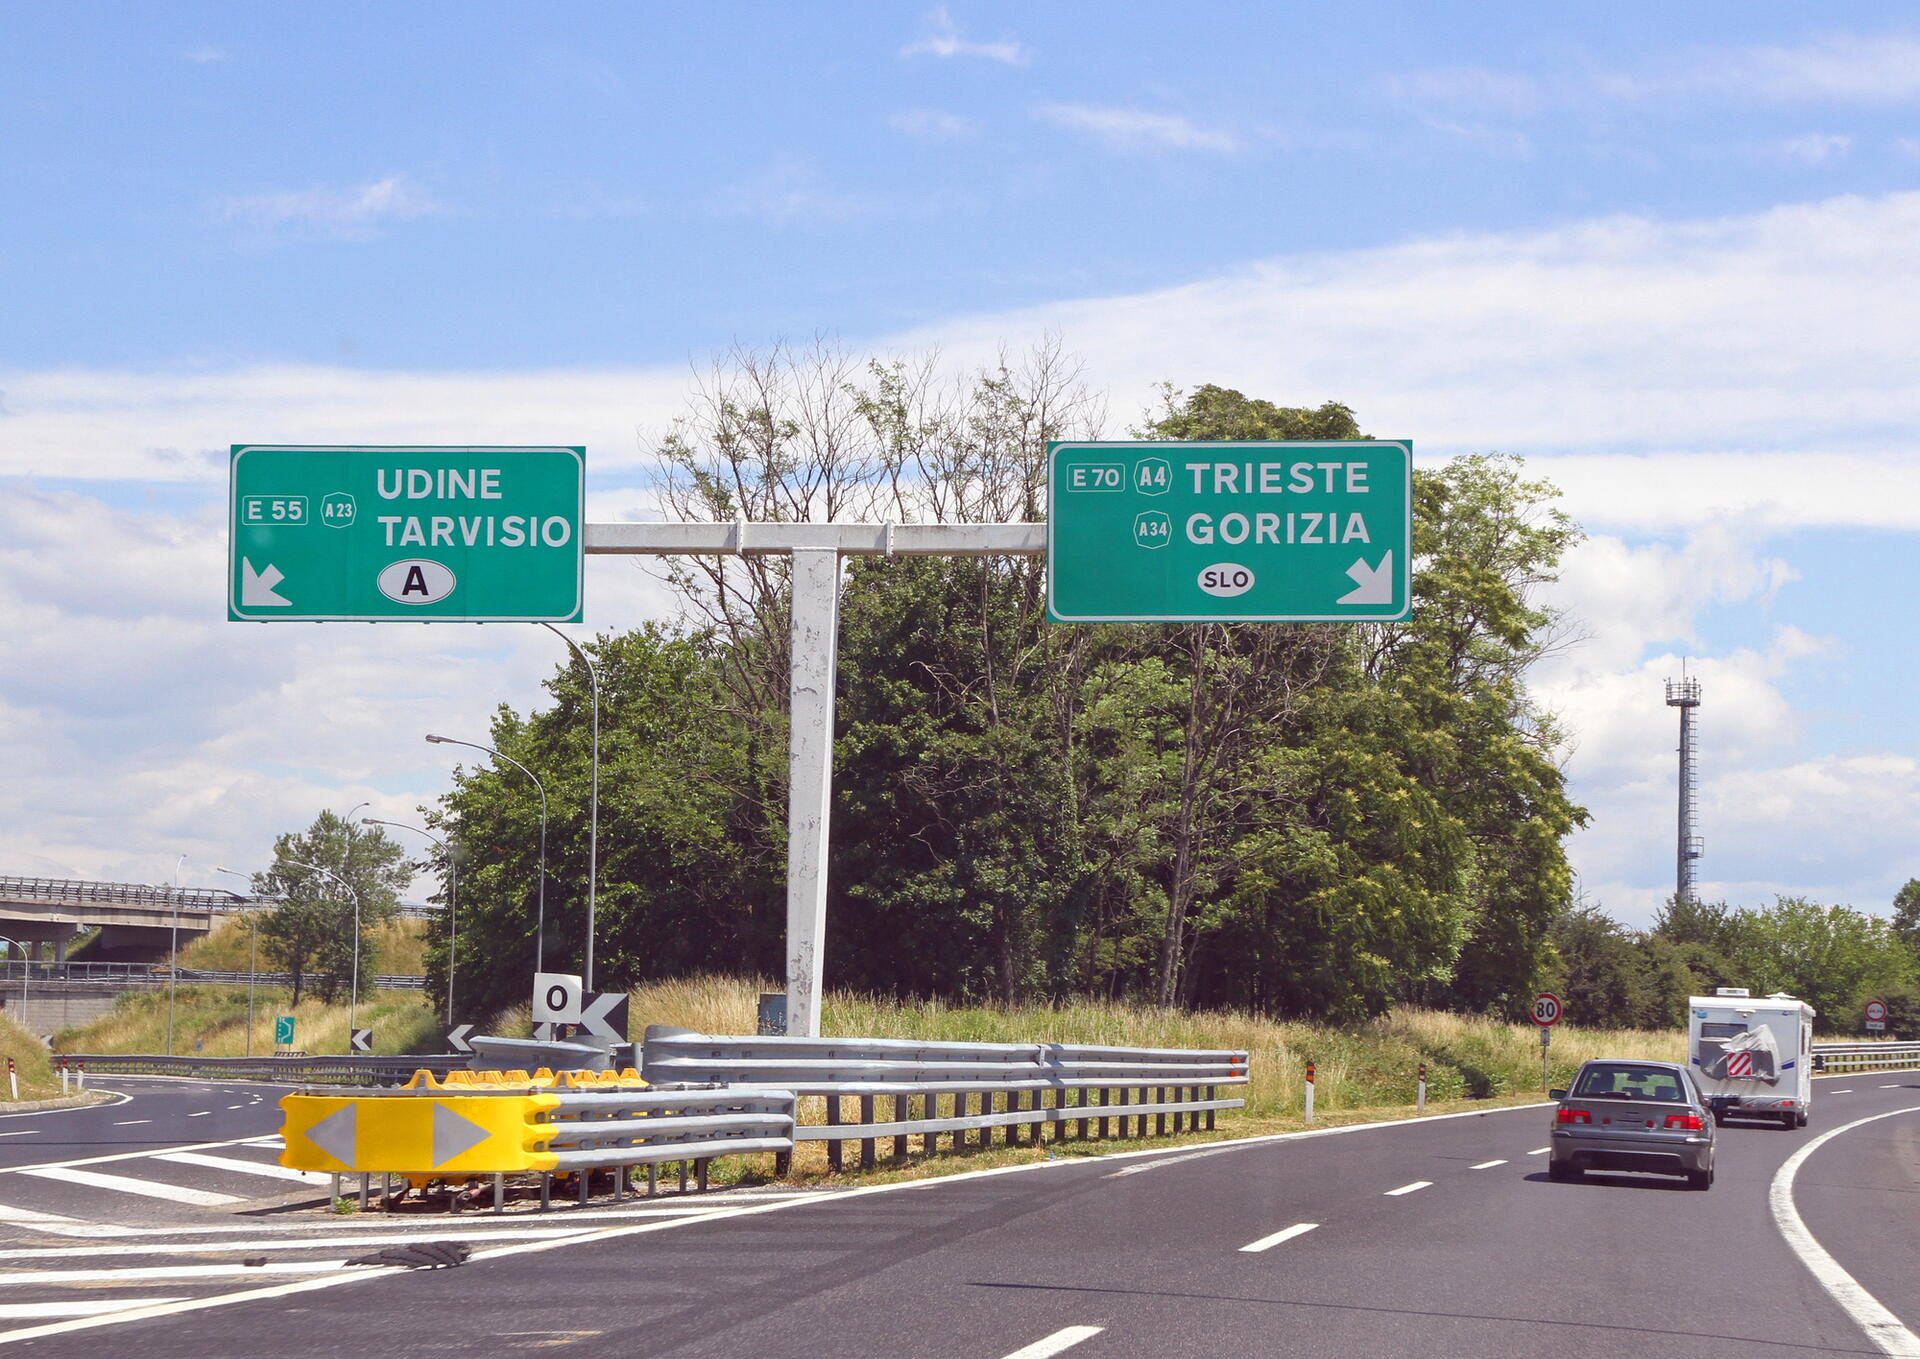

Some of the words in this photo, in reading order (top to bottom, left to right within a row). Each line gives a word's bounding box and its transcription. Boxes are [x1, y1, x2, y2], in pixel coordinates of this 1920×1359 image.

[377, 468, 503, 500] UDINE
[1139, 466, 1166, 487] A4
[1185, 461, 1370, 494] TRIESTE
[248, 500, 263, 520] E
[271, 500, 303, 520] 55
[377, 515, 571, 548] TARVISIO
[1139, 521, 1168, 537] A34
[1185, 512, 1371, 545] GORIZIA
[401, 565, 429, 596] A
[1203, 571, 1249, 588] SLO
[1536, 1002, 1556, 1018] 80
